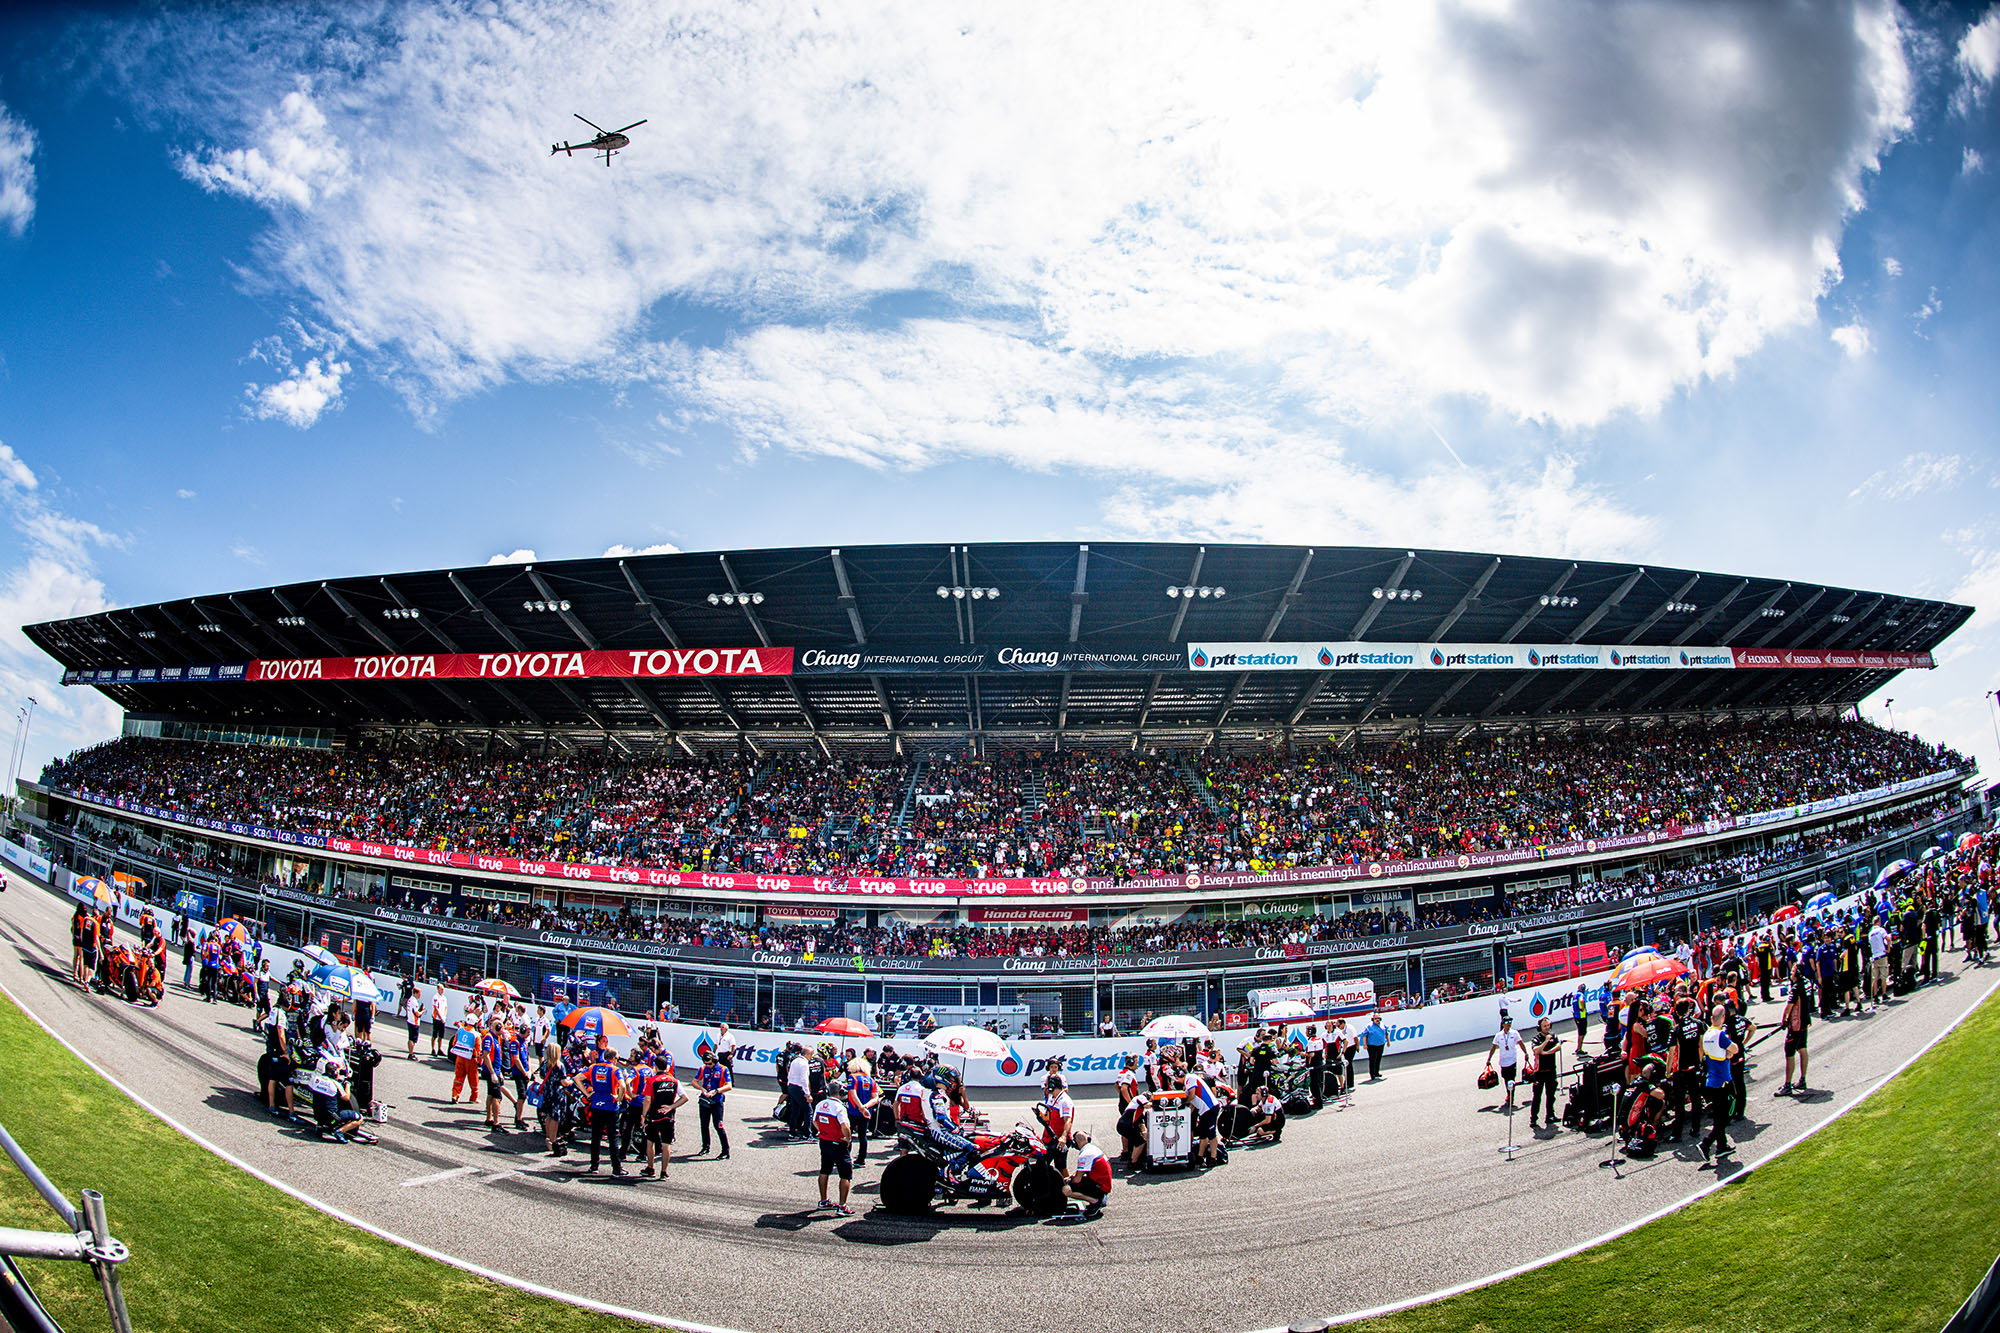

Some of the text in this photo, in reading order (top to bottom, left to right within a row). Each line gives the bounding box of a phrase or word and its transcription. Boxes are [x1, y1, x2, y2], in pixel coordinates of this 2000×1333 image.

[629, 649, 763, 674] TOYOTA
[802, 649, 860, 668] Chang
[944, 655, 984, 663] CIRCUIT
[998, 648, 1058, 666] Chang
[1747, 655, 1780, 664] HONDA
[1793, 655, 1821, 664] HONDA
[224, 665, 243, 675] YAMAHA
[260, 660, 322, 679] TOYOTA
[354, 656, 436, 678] TOYOTA
[478, 653, 584, 676] TOYOTA
[167, 668, 181, 676] YAMAHA
[193, 667, 210, 676] YAMAHA
[144, 806, 153, 815] SCB
[159, 809, 168, 817] SCB
[175, 813, 185, 822] SCB
[211, 820, 222, 830] SCB
[232, 823, 243, 833] SCB
[253, 827, 266, 837] SCB
[303, 836, 317, 846] SCB
[333, 839, 350, 851] true
[362, 843, 381, 855] true
[394, 847, 415, 859] true
[1472, 854, 1494, 866] Every
[1497, 849, 1533, 862] mouthful
[1546, 842, 1584, 856] eaningful
[178, 863, 191, 874] Chang
[478, 857, 503, 870] true
[519, 860, 545, 874] true
[563, 864, 591, 878] true
[650, 869, 680, 885] true
[1204, 866, 1361, 887] Every mouthful is meaningful
[702, 874, 735, 888] true
[756, 876, 790, 890] true
[859, 879, 896, 893] true
[909, 880, 945, 894] true
[973, 880, 1007, 894] true
[1031, 880, 1067, 894] true
[278, 888, 315, 903] INTERNATIONAL
[316, 896, 336, 907] CIRCUIT
[1372, 892, 1402, 902] YAMAHA
[1633, 896, 1656, 907] Chang
[1658, 888, 1696, 901] INTERNATIONAL
[697, 904, 714, 912] SCB
[768, 907, 799, 916] TOYOTA
[1262, 902, 1298, 914] Chang
[375, 906, 398, 922] Chang
[451, 922, 479, 933] CIRCUIT
[984, 910, 1072, 920] Honda Racing
[1468, 924, 1499, 935] Chang
[1558, 910, 1584, 921] CIRCUIT
[540, 932, 681, 956] Chang INTERNATIONAL CIRCUIT
[1255, 947, 1286, 959] Chan
[1373, 936, 1408, 948] CIRCUIT
[752, 951, 792, 967] Chang
[880, 960, 923, 969] CIRCUIT
[1003, 958, 1046, 972] Chang
[1137, 956, 1180, 967] CIRCUIT
[1391, 962, 1404, 971] 17
[596, 967, 608, 975] 12
[695, 977, 708, 985] 13
[806, 984, 820, 993] 14
[1319, 990, 1372, 1004] PRAMAC
[941, 1046, 967, 1054] PRAMAC
